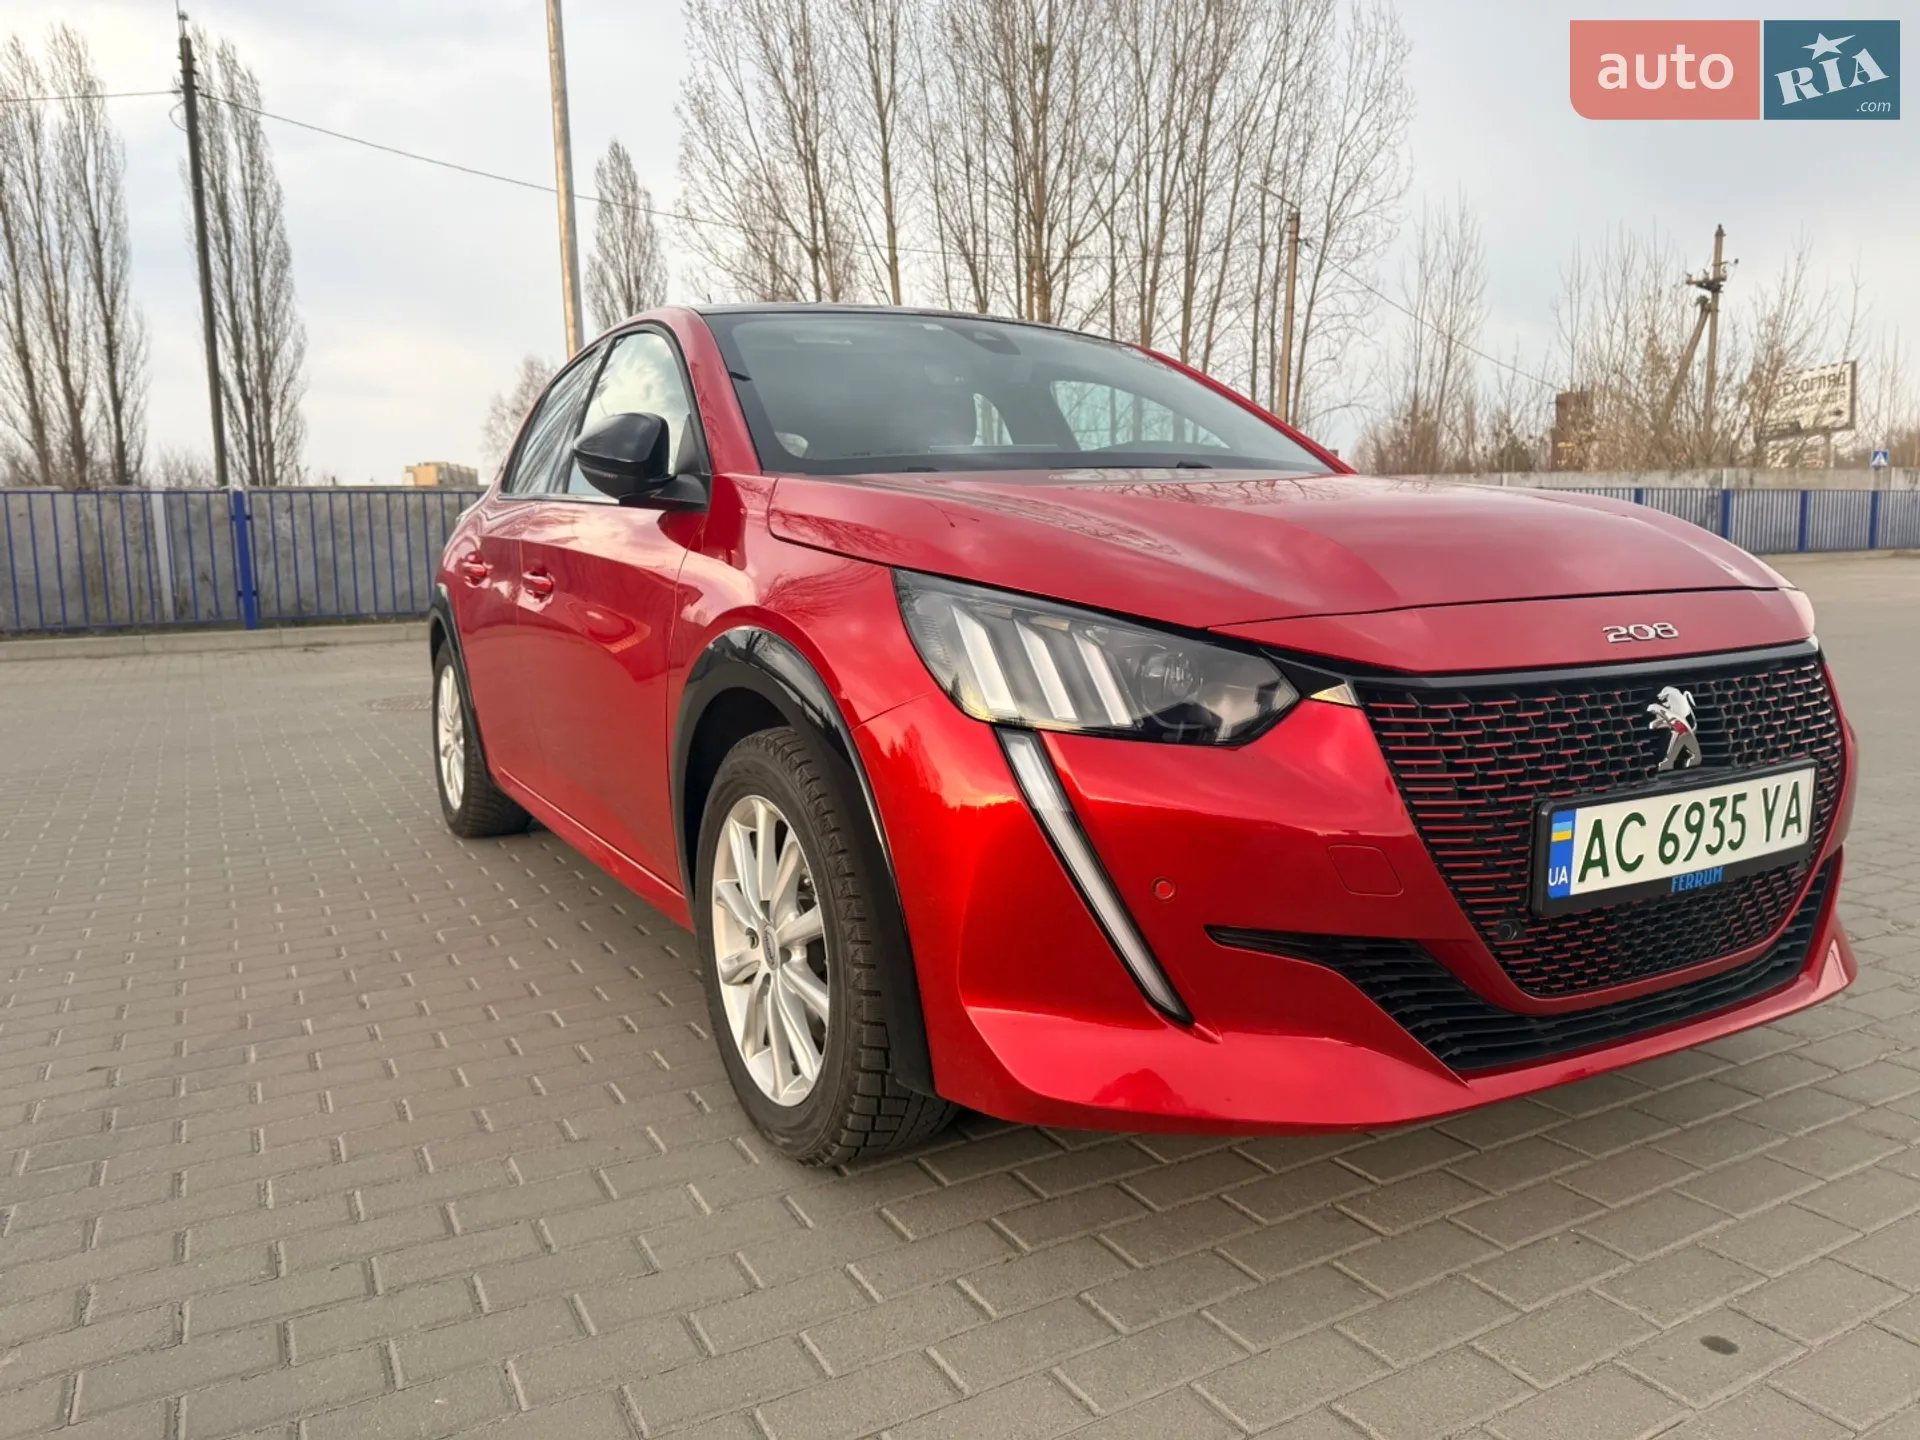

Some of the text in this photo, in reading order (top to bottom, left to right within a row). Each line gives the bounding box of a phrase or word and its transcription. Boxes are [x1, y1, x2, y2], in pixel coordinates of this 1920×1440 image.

[1775, 371, 1847, 398] ТЕХОГЛЯД
[1602, 622, 1680, 643] 208
[1577, 780, 1802, 884] AC 6935 YA
[1548, 866, 1569, 887] UA
[1671, 867, 1725, 893] FERRUM
